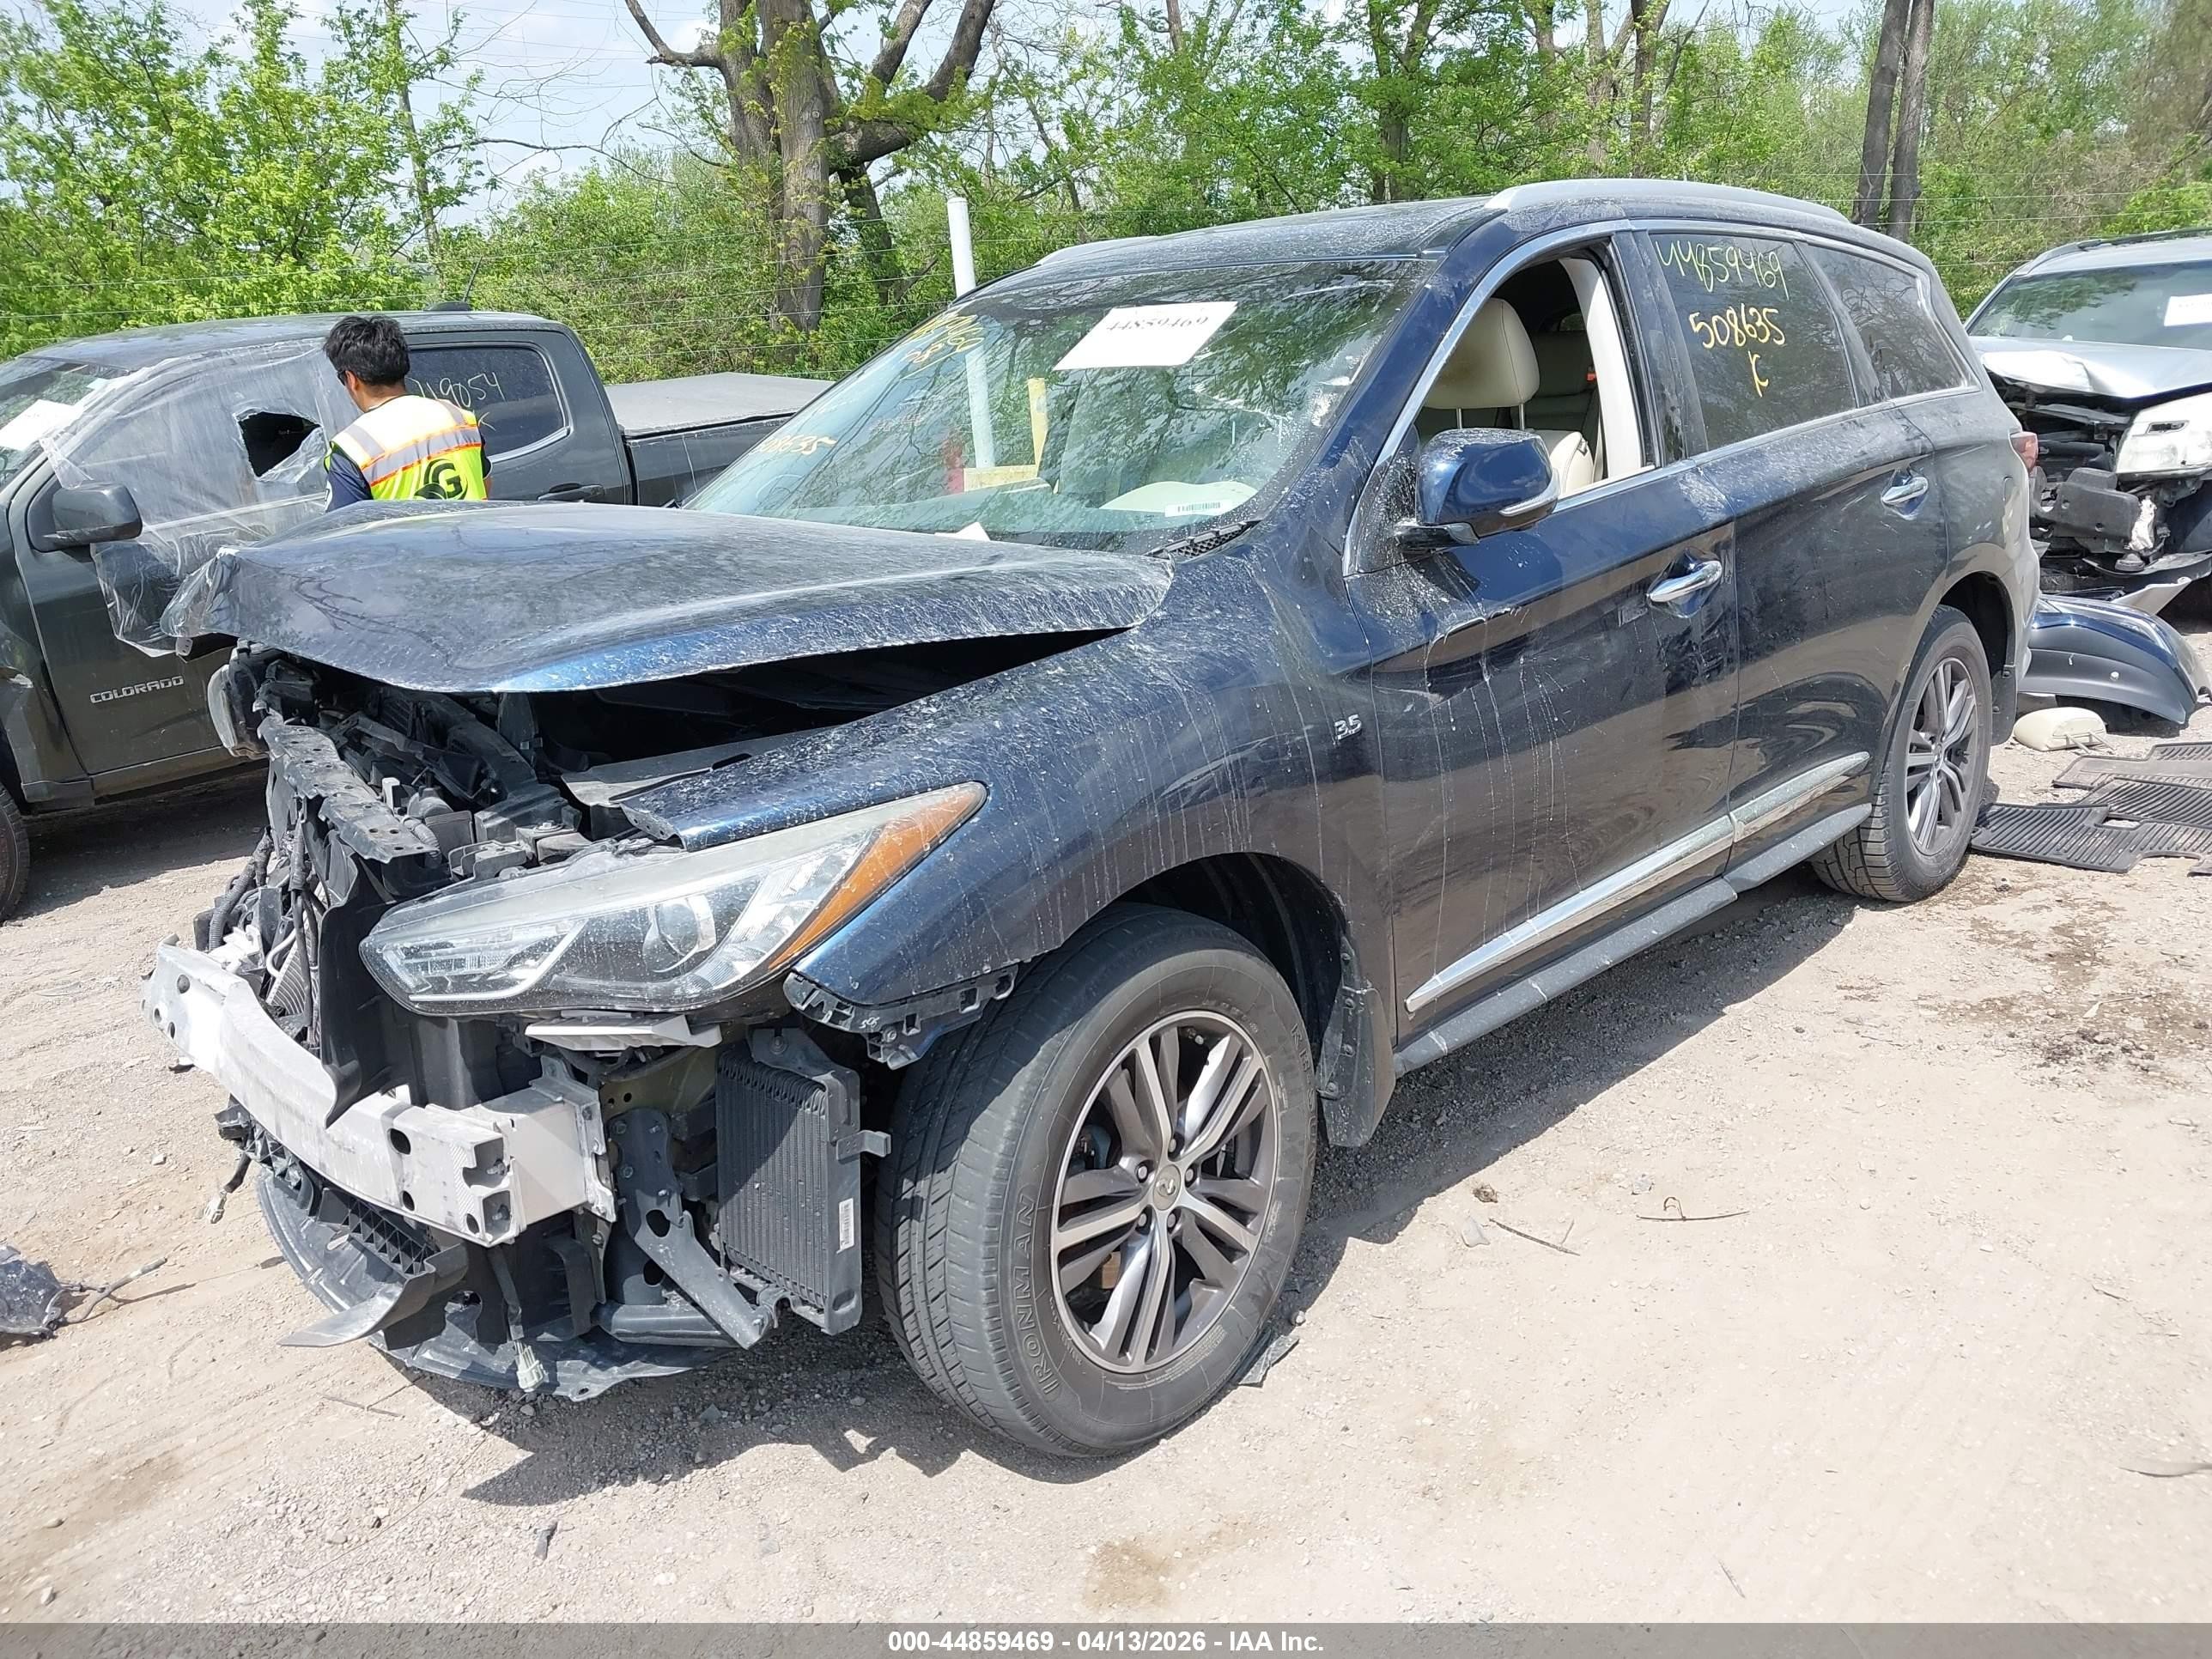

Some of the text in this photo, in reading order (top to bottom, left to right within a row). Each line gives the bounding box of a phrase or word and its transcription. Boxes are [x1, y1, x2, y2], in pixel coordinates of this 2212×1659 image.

[1655, 240, 1790, 301] 44859469
[1688, 303, 1786, 349] 508635
[89, 675, 185, 703] COLORADO
[1014, 1192, 1060, 1395] IRONMAN
